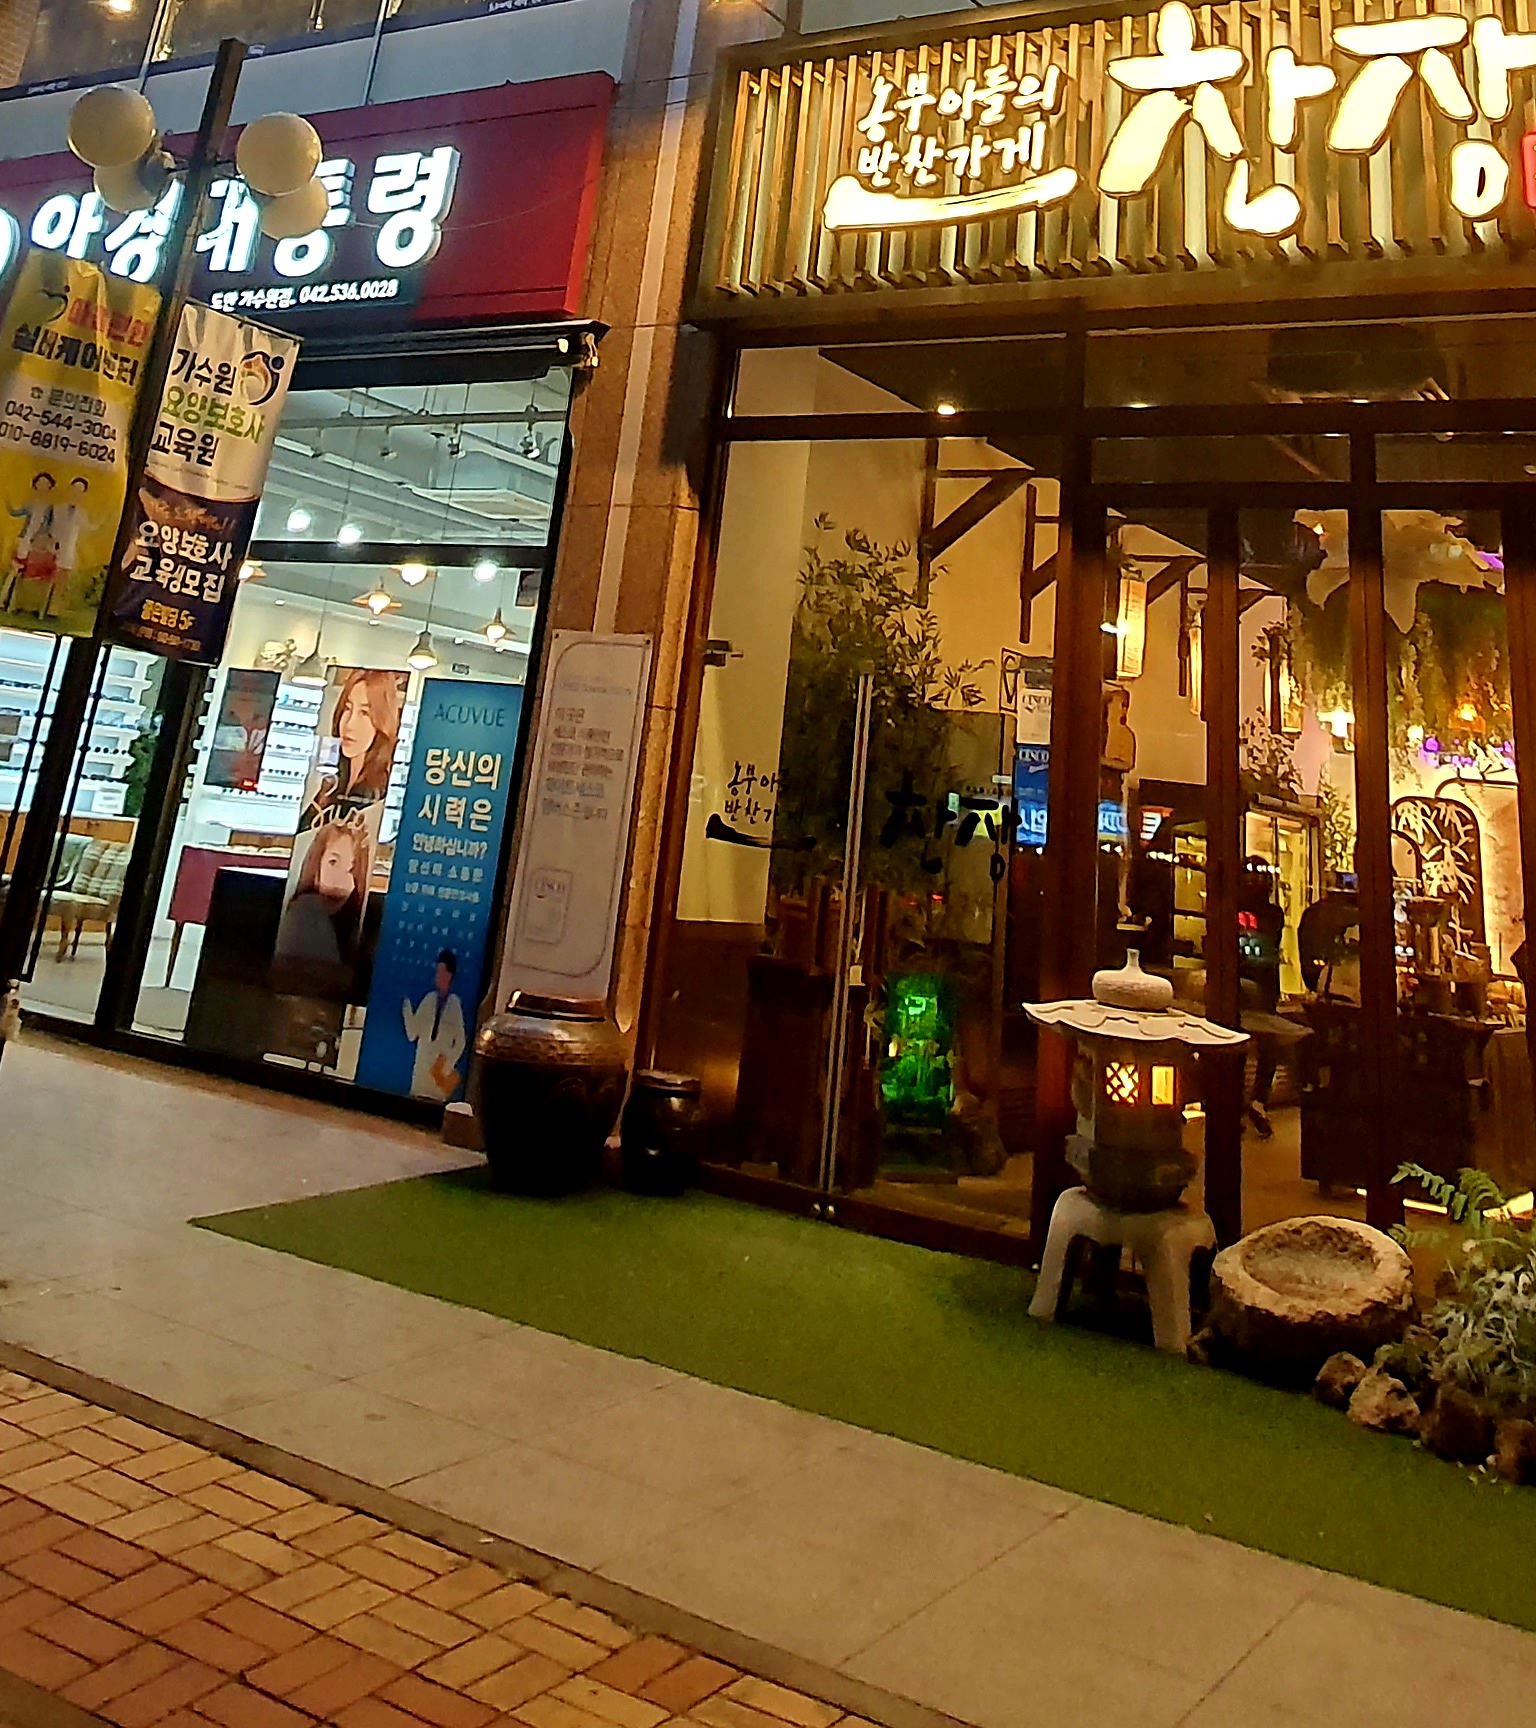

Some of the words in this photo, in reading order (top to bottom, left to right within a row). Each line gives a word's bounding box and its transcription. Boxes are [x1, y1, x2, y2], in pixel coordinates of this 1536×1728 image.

[855, 62, 1061, 139] 농부아들의
[857, 124, 1046, 181] 반찬가게
[171, 348, 239, 397] 가수원
[163, 385, 266, 444] 요양보호사
[150, 421, 220, 468] 교육원
[135, 520, 233, 571] 요양보호사
[433, 700, 507, 729] ACUVUE
[422, 746, 503, 791] 당신의
[416, 794, 493, 834] 시력은
[411, 832, 489, 862] 안녕하십니까?
